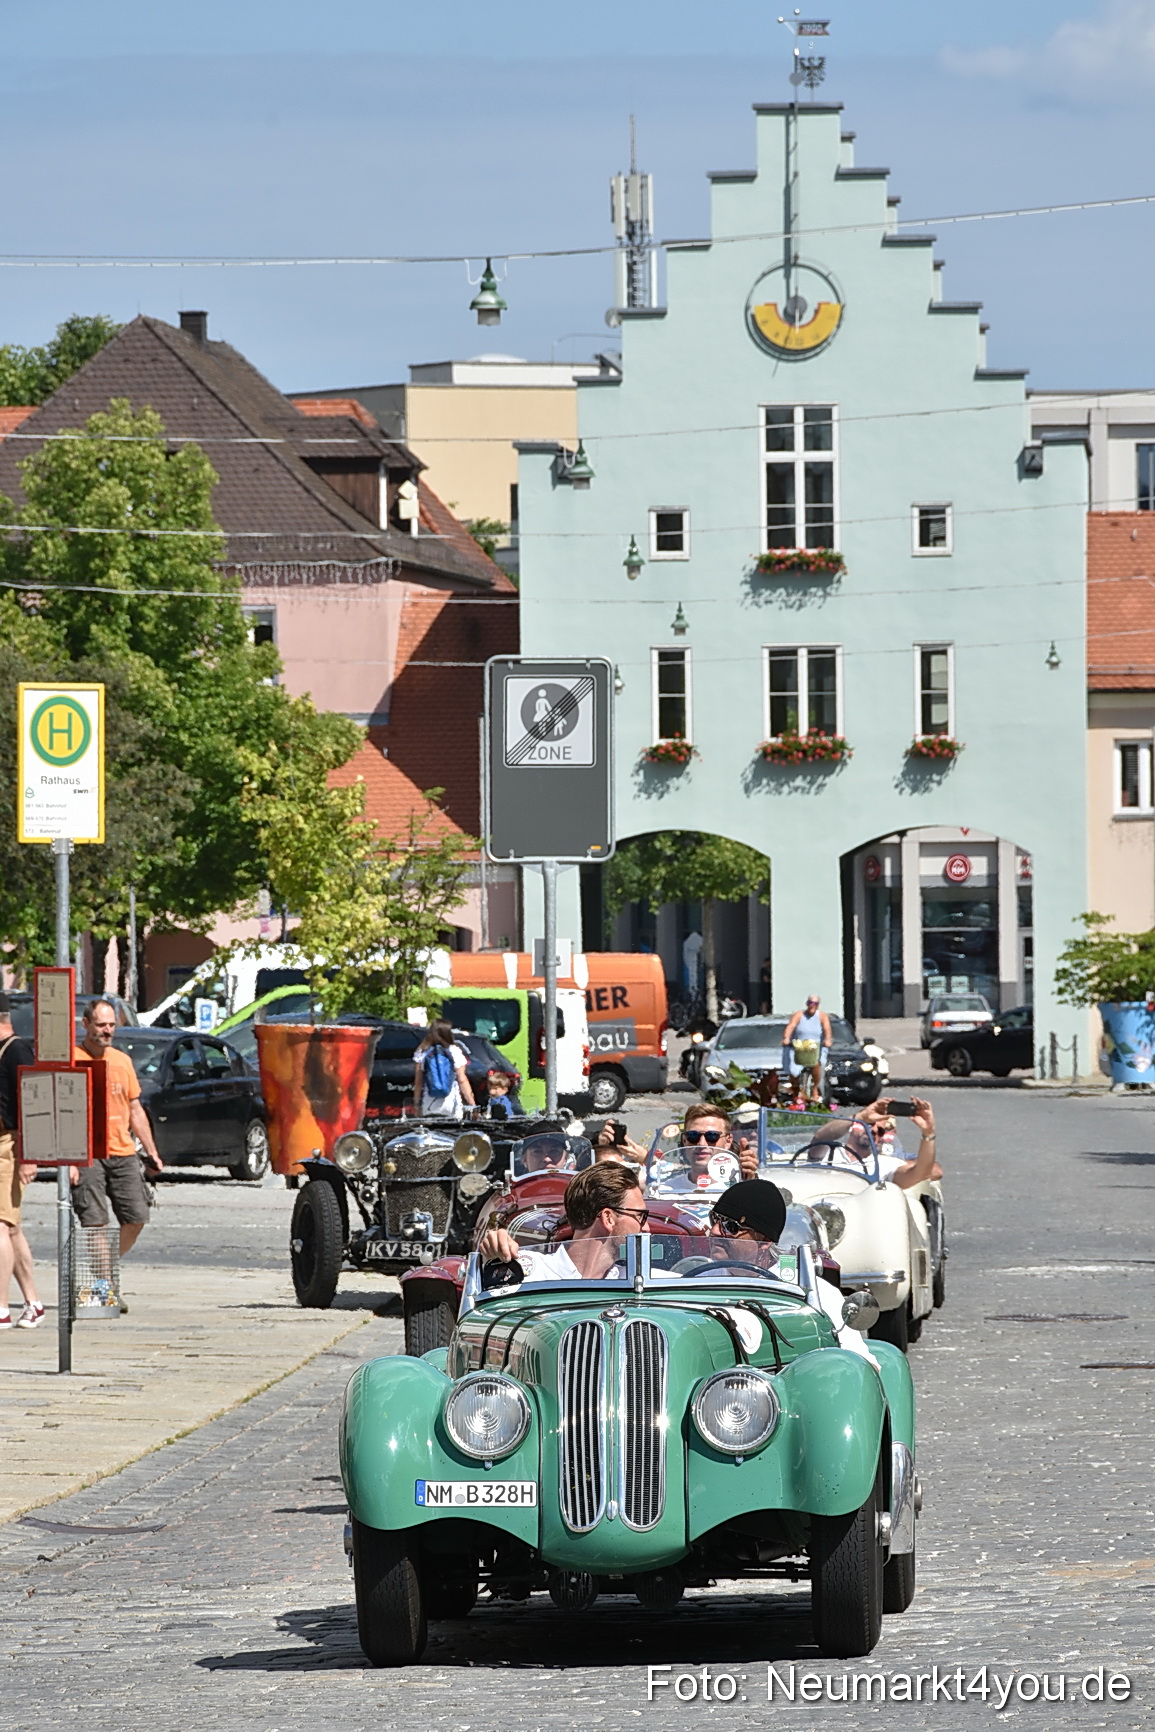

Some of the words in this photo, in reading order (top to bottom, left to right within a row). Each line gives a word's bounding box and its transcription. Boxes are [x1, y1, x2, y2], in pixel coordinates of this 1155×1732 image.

[48, 712, 73, 750] H
[528, 746, 572, 760] ZONE
[40, 775, 81, 785] Rathaus
[719, 1165, 726, 1175] 6
[426, 1485, 453, 1503] NM
